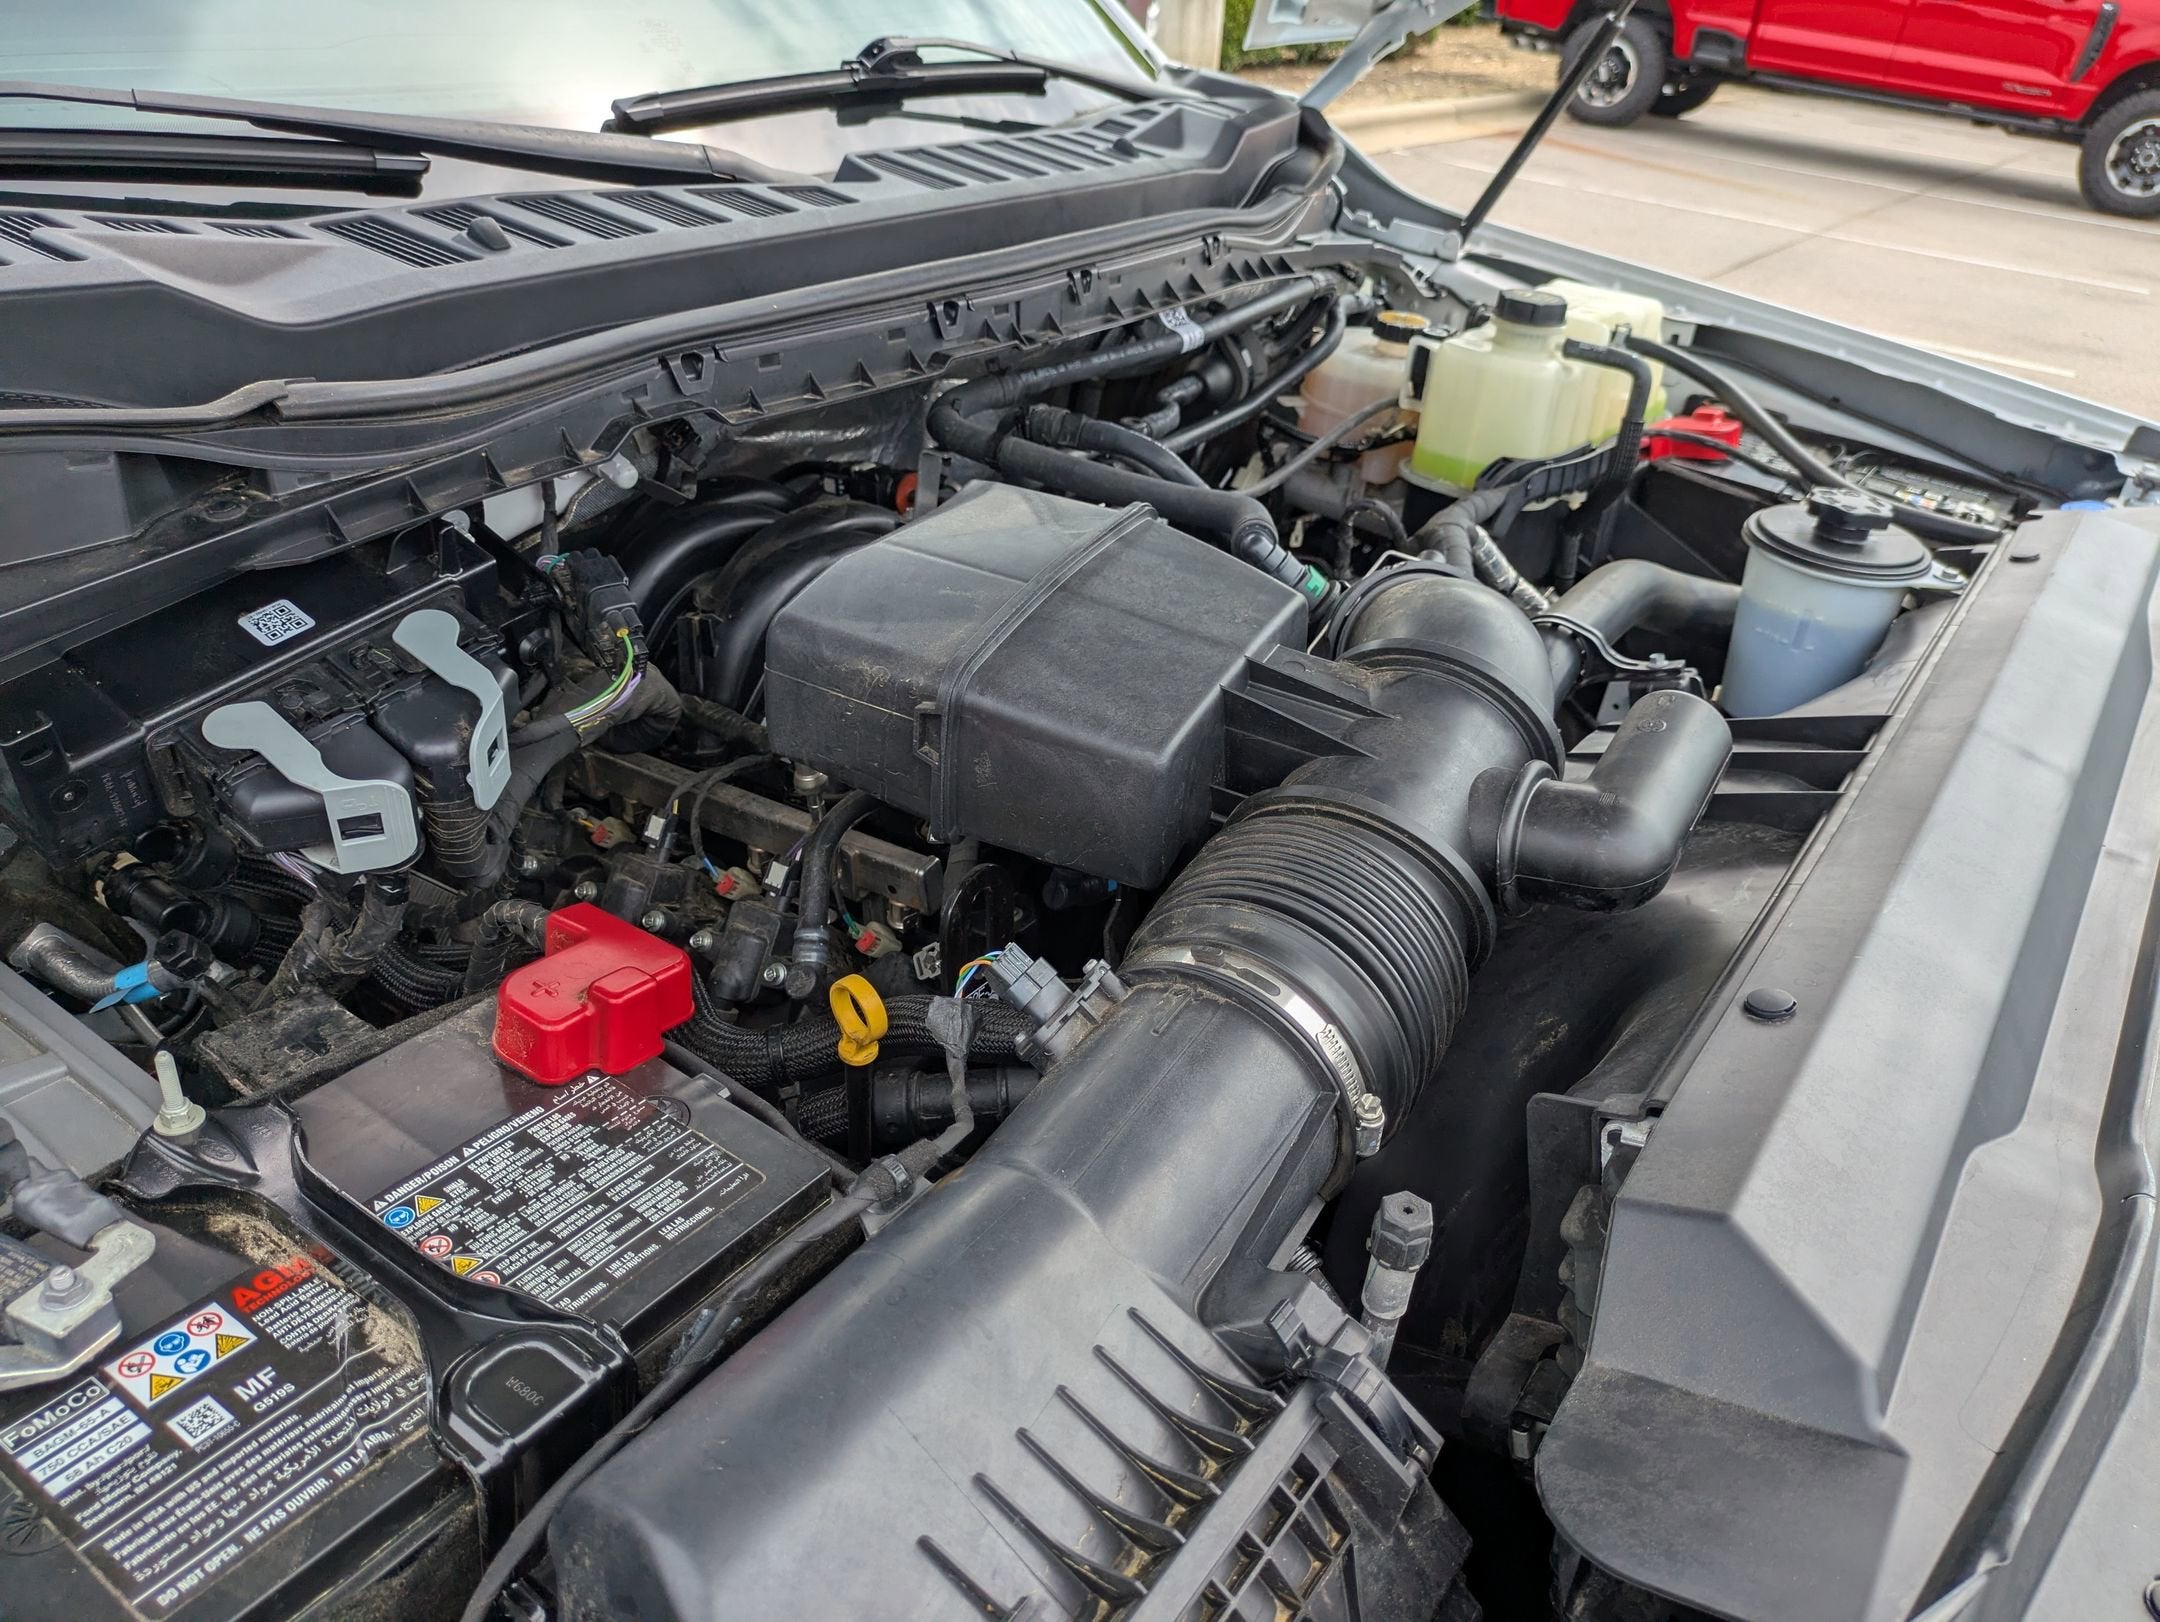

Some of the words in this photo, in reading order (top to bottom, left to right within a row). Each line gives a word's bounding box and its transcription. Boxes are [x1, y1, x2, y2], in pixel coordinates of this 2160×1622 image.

[470, 1104, 546, 1150] PELIGRO/VENENO
[501, 1140, 515, 1149] LES
[382, 1155, 461, 1202] DANGER/POISON
[489, 1155, 504, 1164] LES
[499, 1148, 515, 1158] GAZ
[399, 1214, 436, 1236] EXPLOSIVE
[430, 1202, 454, 1217] GASES
[460, 1186, 480, 1199] CAUSE
[518, 1200, 545, 1217] L'ACIDE
[539, 1179, 577, 1204] SULFURIQUE
[583, 1203, 594, 1211] LA
[467, 1229, 499, 1251] SULFURIC
[494, 1221, 512, 1233] ACID
[657, 1225, 672, 1235] LEA
[669, 1216, 685, 1227] LAS
[508, 1252, 523, 1261] OUT
[518, 1246, 530, 1254] OF
[526, 1240, 540, 1250] THE
[519, 1256, 530, 1264] OF
[604, 1259, 624, 1273] LIRE
[619, 1251, 636, 1262] LES
[230, 1256, 312, 1311] AGM
[251, 1276, 321, 1322] NON-SPILLABLE
[257, 1311, 280, 1327] Lead
[279, 1298, 300, 1313] Acid
[298, 1280, 329, 1301] Battery
[265, 1310, 299, 1333] Batterie
[299, 1303, 311, 1311] au
[309, 1286, 337, 1305] plomb
[271, 1323, 292, 1338] ANTI
[278, 1320, 314, 1345] CONTRA
[233, 1365, 281, 1401] MF
[251, 1381, 295, 1413] G519S
[1, 1381, 103, 1448] FoMoCo
[31, 1406, 111, 1459] BAGM-65-A
[221, 1465, 247, 1484] avec
[243, 1453, 263, 1468] des
[260, 1424, 305, 1456] matériaux
[301, 1392, 349, 1427] américains
[343, 1383, 355, 1393] et
[38, 1456, 66, 1476] 750
[65, 1414, 130, 1459] CCA/SAE
[63, 1467, 83, 1482] 68
[82, 1453, 105, 1469] Ah
[104, 1434, 134, 1455] C20
[239, 1473, 259, 1488] con
[255, 1440, 304, 1476] materiales
[102, 1527, 134, 1551] Made
[130, 1519, 145, 1531] in
[141, 1504, 166, 1523] USA
[184, 1480, 202, 1493] US
[199, 1467, 220, 1483] and
[216, 1439, 260, 1471] imported
[155, 1586, 180, 1606] DO
[175, 1567, 207, 1592] NOT
[201, 1540, 244, 1573] OPEN.
[242, 1524, 265, 1543] NE
[259, 1507, 287, 1530] PAS
[332, 1459, 353, 1477] NO
[347, 1446, 369, 1464] LA
